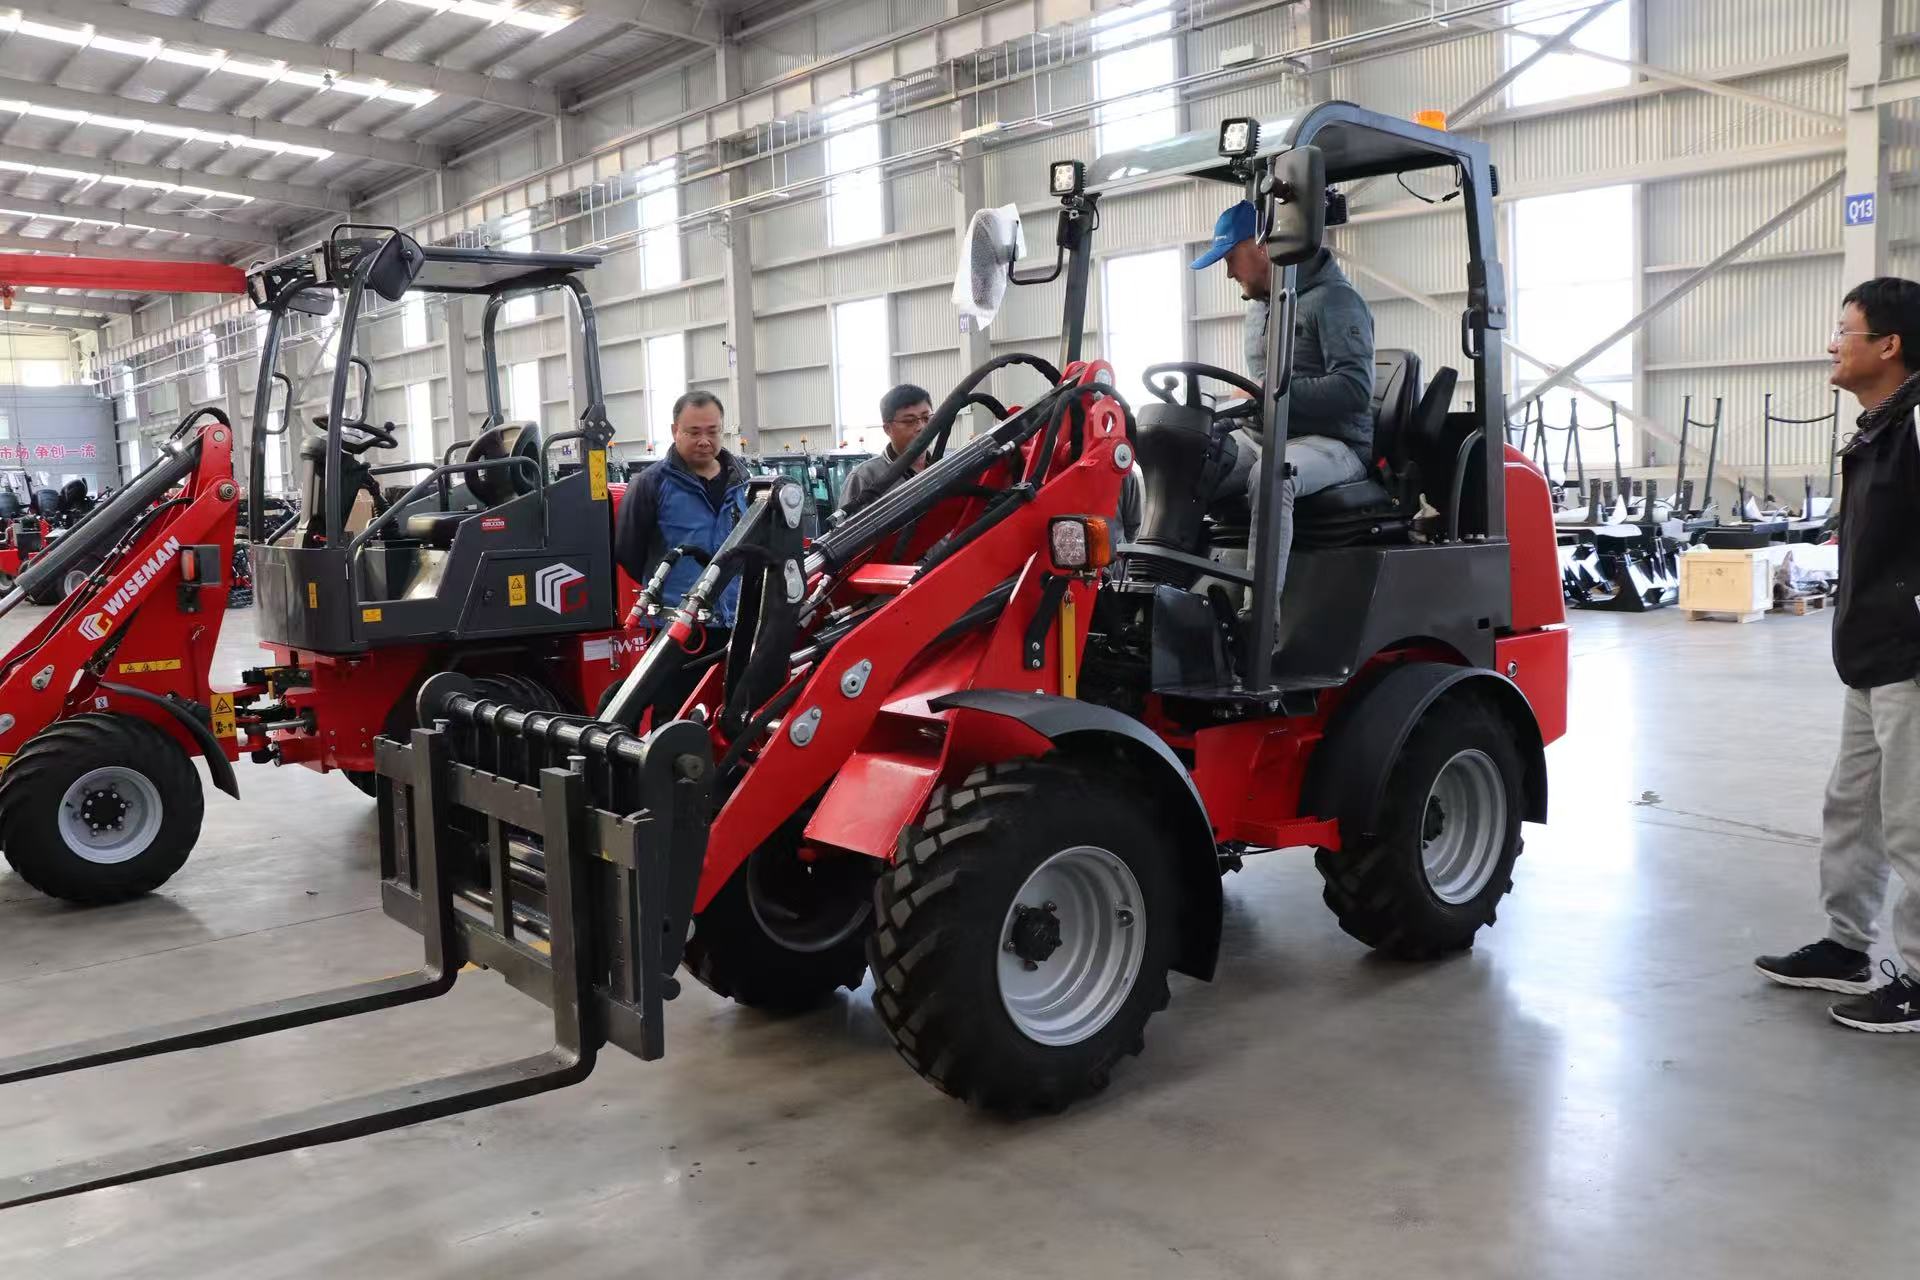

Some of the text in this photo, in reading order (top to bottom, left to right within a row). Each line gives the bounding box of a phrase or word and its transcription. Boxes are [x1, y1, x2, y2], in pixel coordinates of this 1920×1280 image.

[1849, 199, 1873, 223] Q13
[0, 444, 96, 459] 市场 争创一流
[102, 536, 180, 616] WISEMAN
